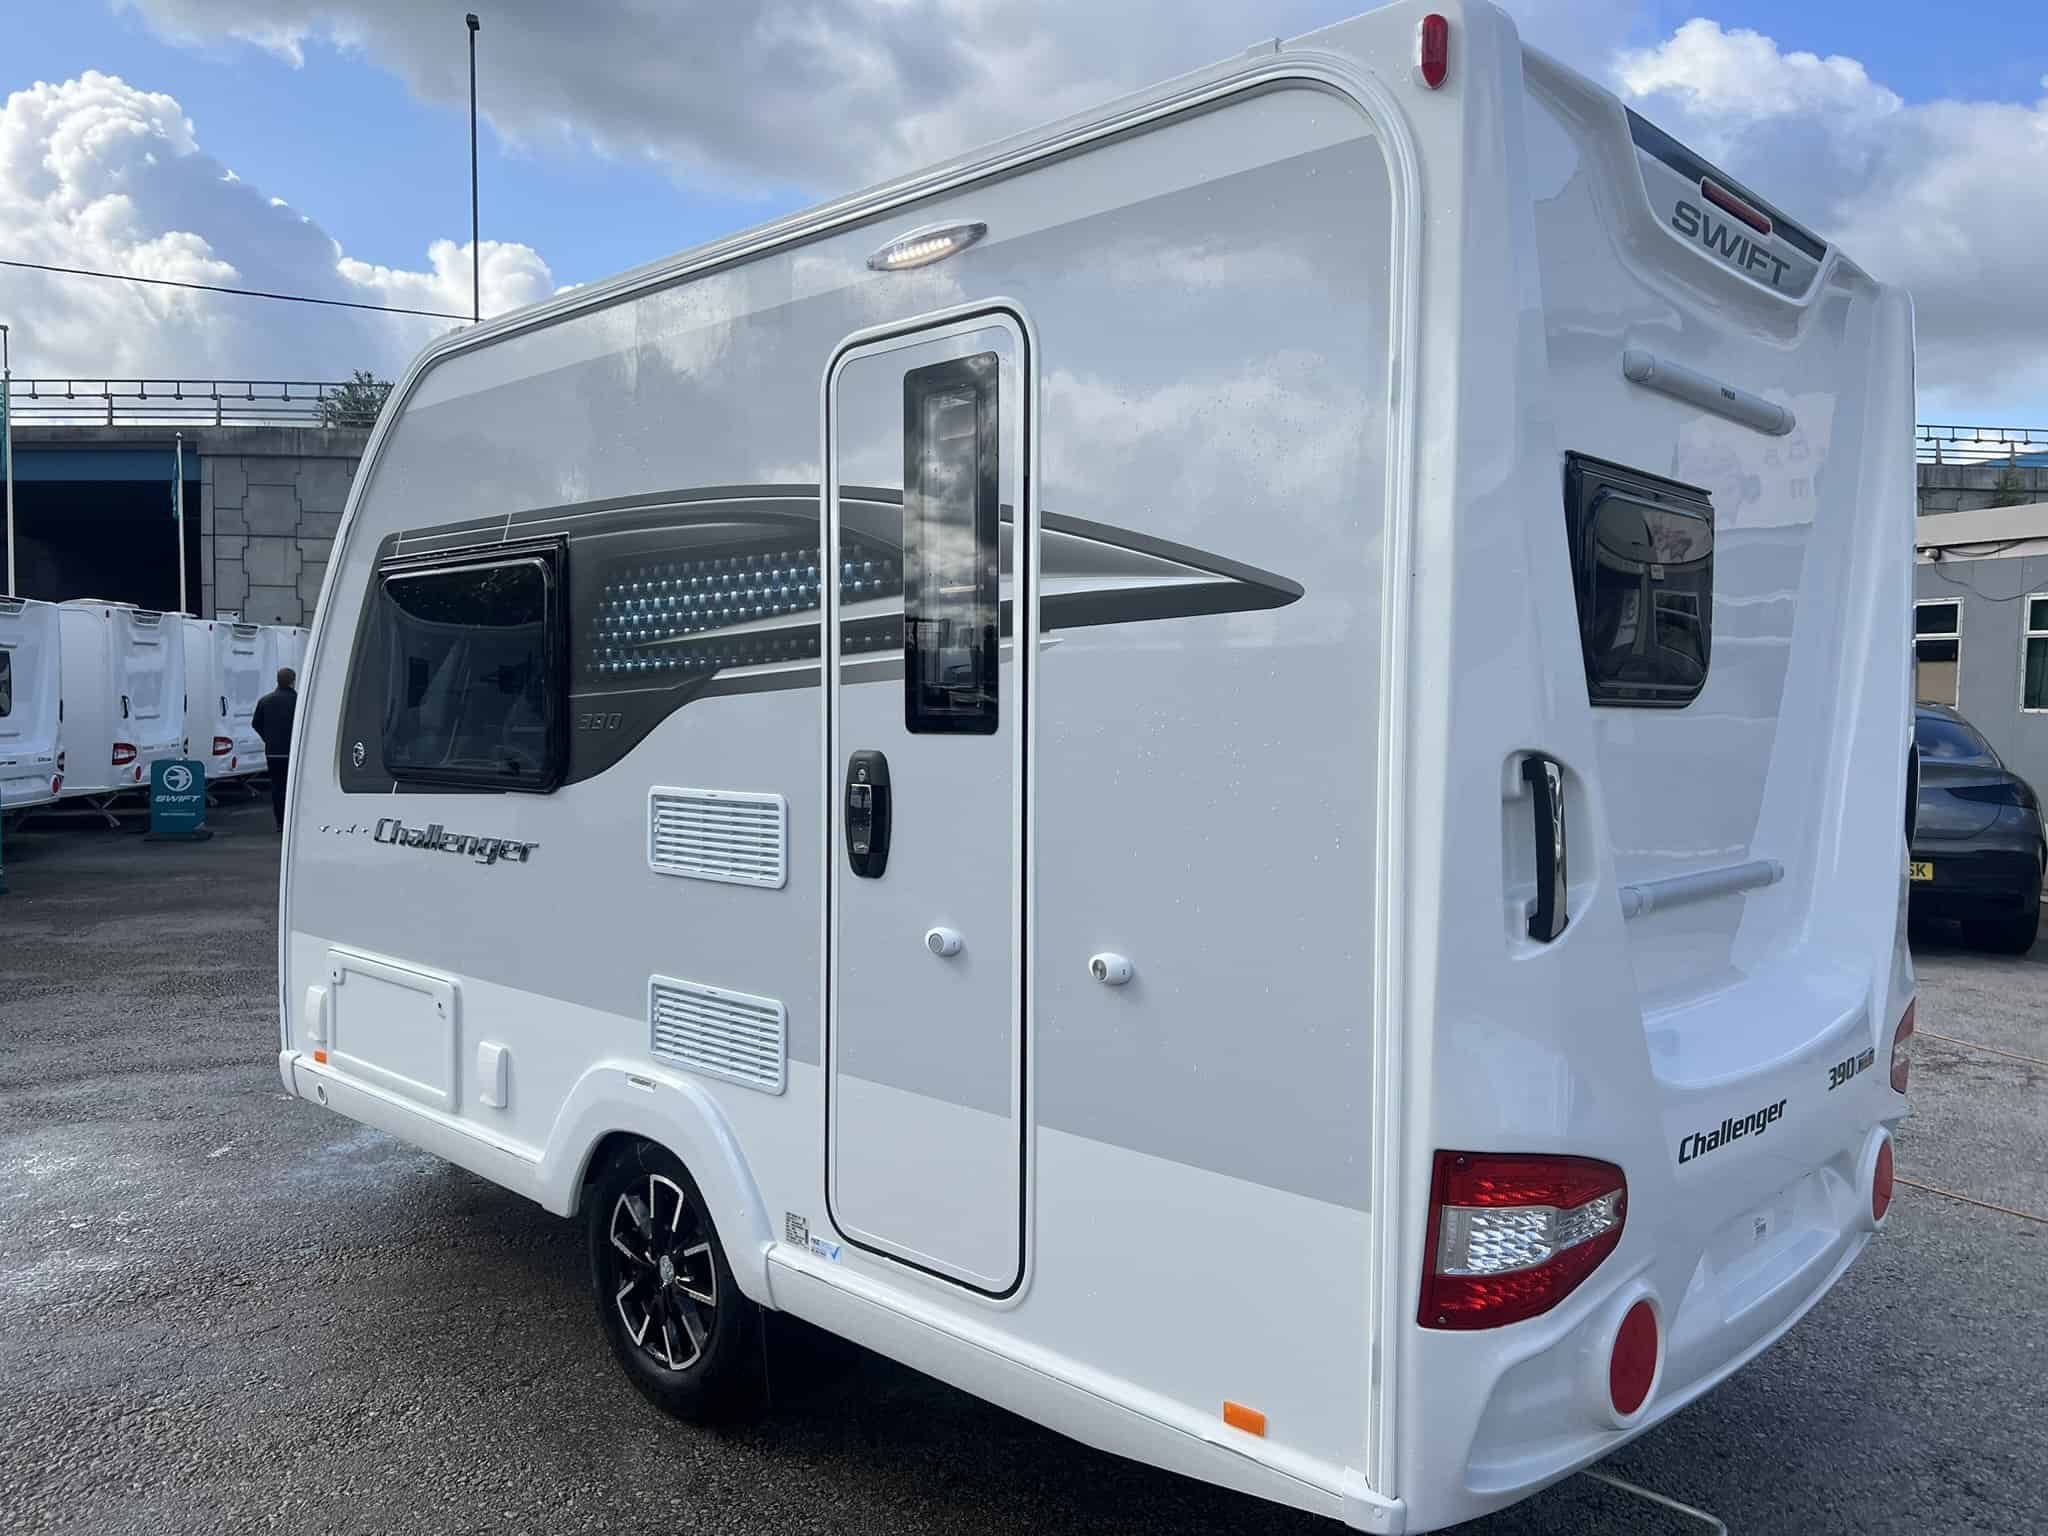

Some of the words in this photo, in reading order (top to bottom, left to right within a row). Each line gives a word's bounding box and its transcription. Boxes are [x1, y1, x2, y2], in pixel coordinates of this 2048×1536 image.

[1672, 200, 1791, 285] SWIFT
[155, 794, 201, 803] SWIFT
[373, 817, 540, 865] Challenger
[1828, 1055, 1856, 1091] 390
[1678, 1098, 1787, 1164] Challenger
